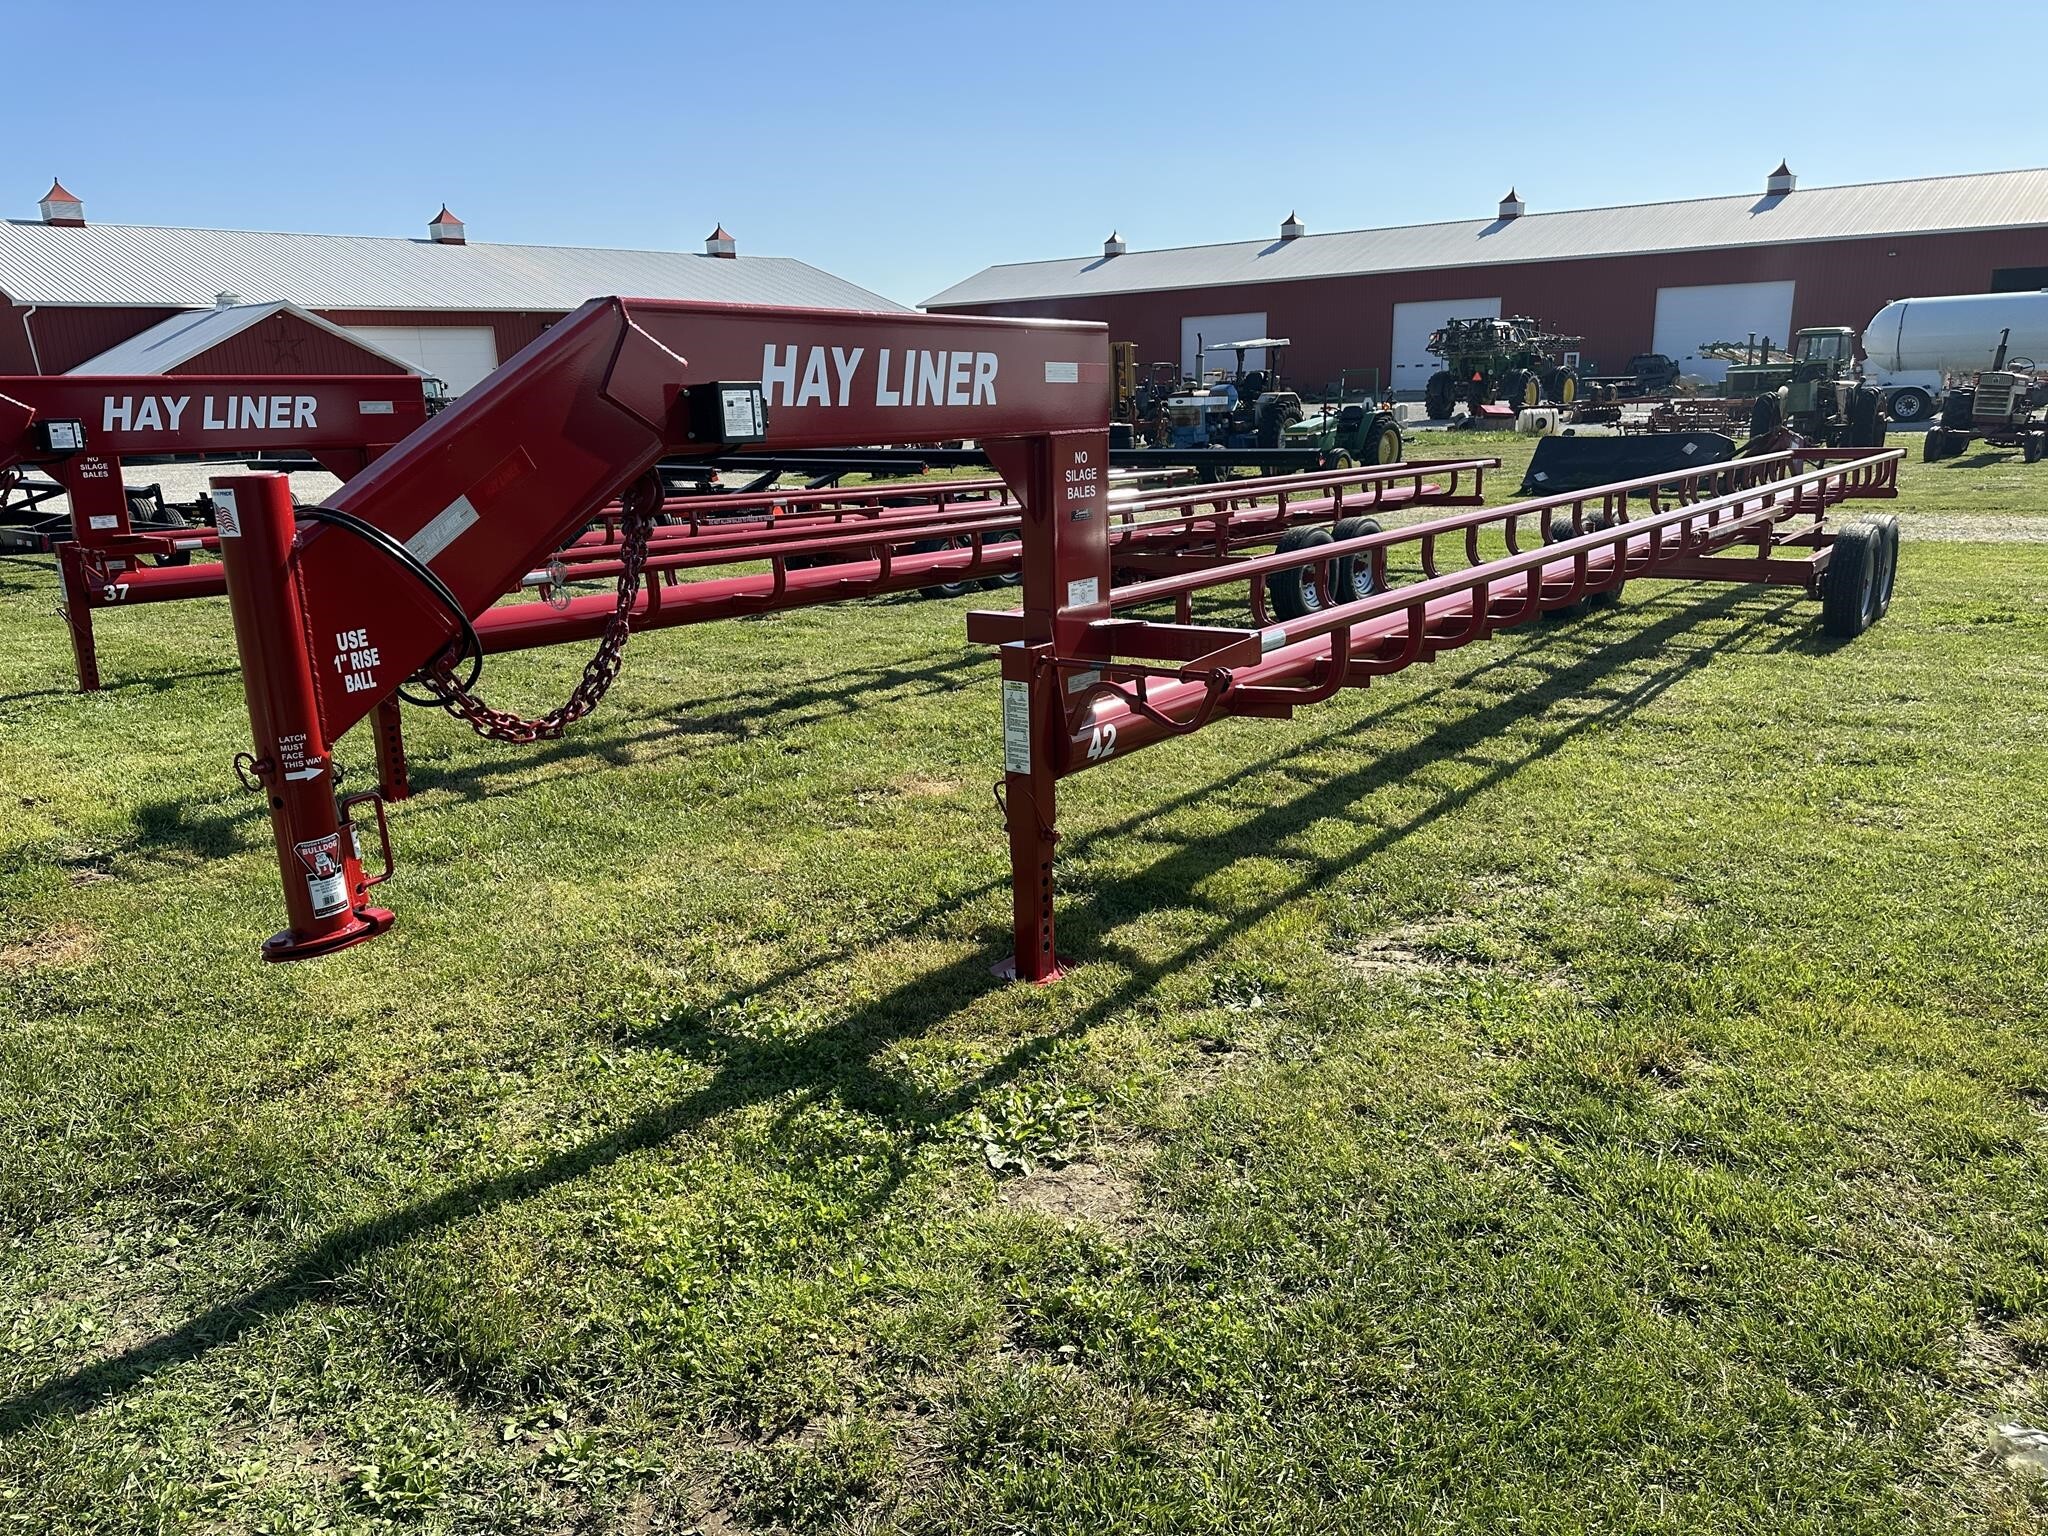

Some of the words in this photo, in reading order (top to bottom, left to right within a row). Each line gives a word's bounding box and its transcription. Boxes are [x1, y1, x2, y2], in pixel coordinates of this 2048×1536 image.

[761, 343, 865, 407] HAY
[875, 348, 999, 407] LINER
[102, 396, 191, 432] HAY
[202, 396, 318, 430] LINER
[1074, 451, 1088, 464] NO
[79, 463, 109, 471] SILAGE
[82, 470, 109, 479] BALES
[1065, 467, 1098, 483] SILAGE
[1067, 485, 1096, 500] BALES
[103, 583, 129, 601] 37
[335, 628, 369, 651] USE
[333, 654, 347, 673] 1"
[350, 647, 380, 671] RISE
[344, 670, 377, 693] BALL
[278, 733, 307, 744] LATCH
[1087, 723, 1117, 761] 42
[280, 742, 304, 752] MUST
[281, 751, 305, 761] FACE
[283, 760, 305, 769] THIS
[305, 755, 323, 766] WAY
[302, 840, 338, 856] BULLDOG
